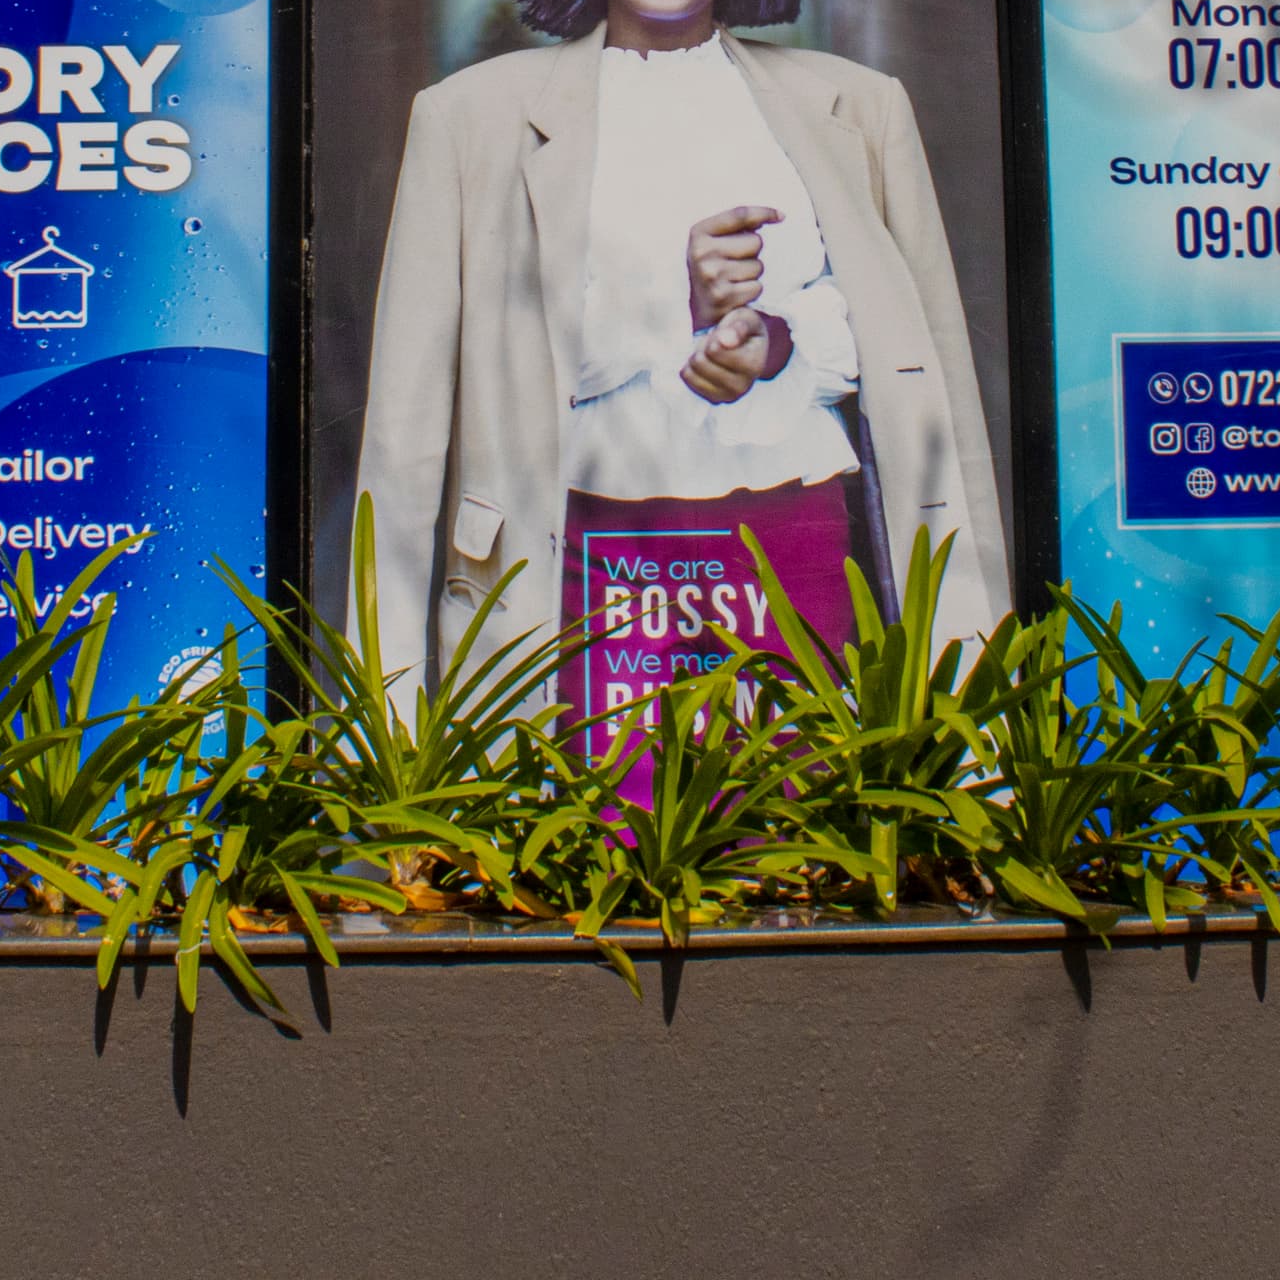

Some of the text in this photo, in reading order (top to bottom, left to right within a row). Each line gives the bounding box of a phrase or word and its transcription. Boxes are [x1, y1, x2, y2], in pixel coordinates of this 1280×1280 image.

[1109, 156, 1270, 189] Sunday
[603, 556, 725, 581] We are
[604, 583, 771, 640] BOSSY
[158, 655, 182, 685] ECO
[604, 649, 662, 674] We
